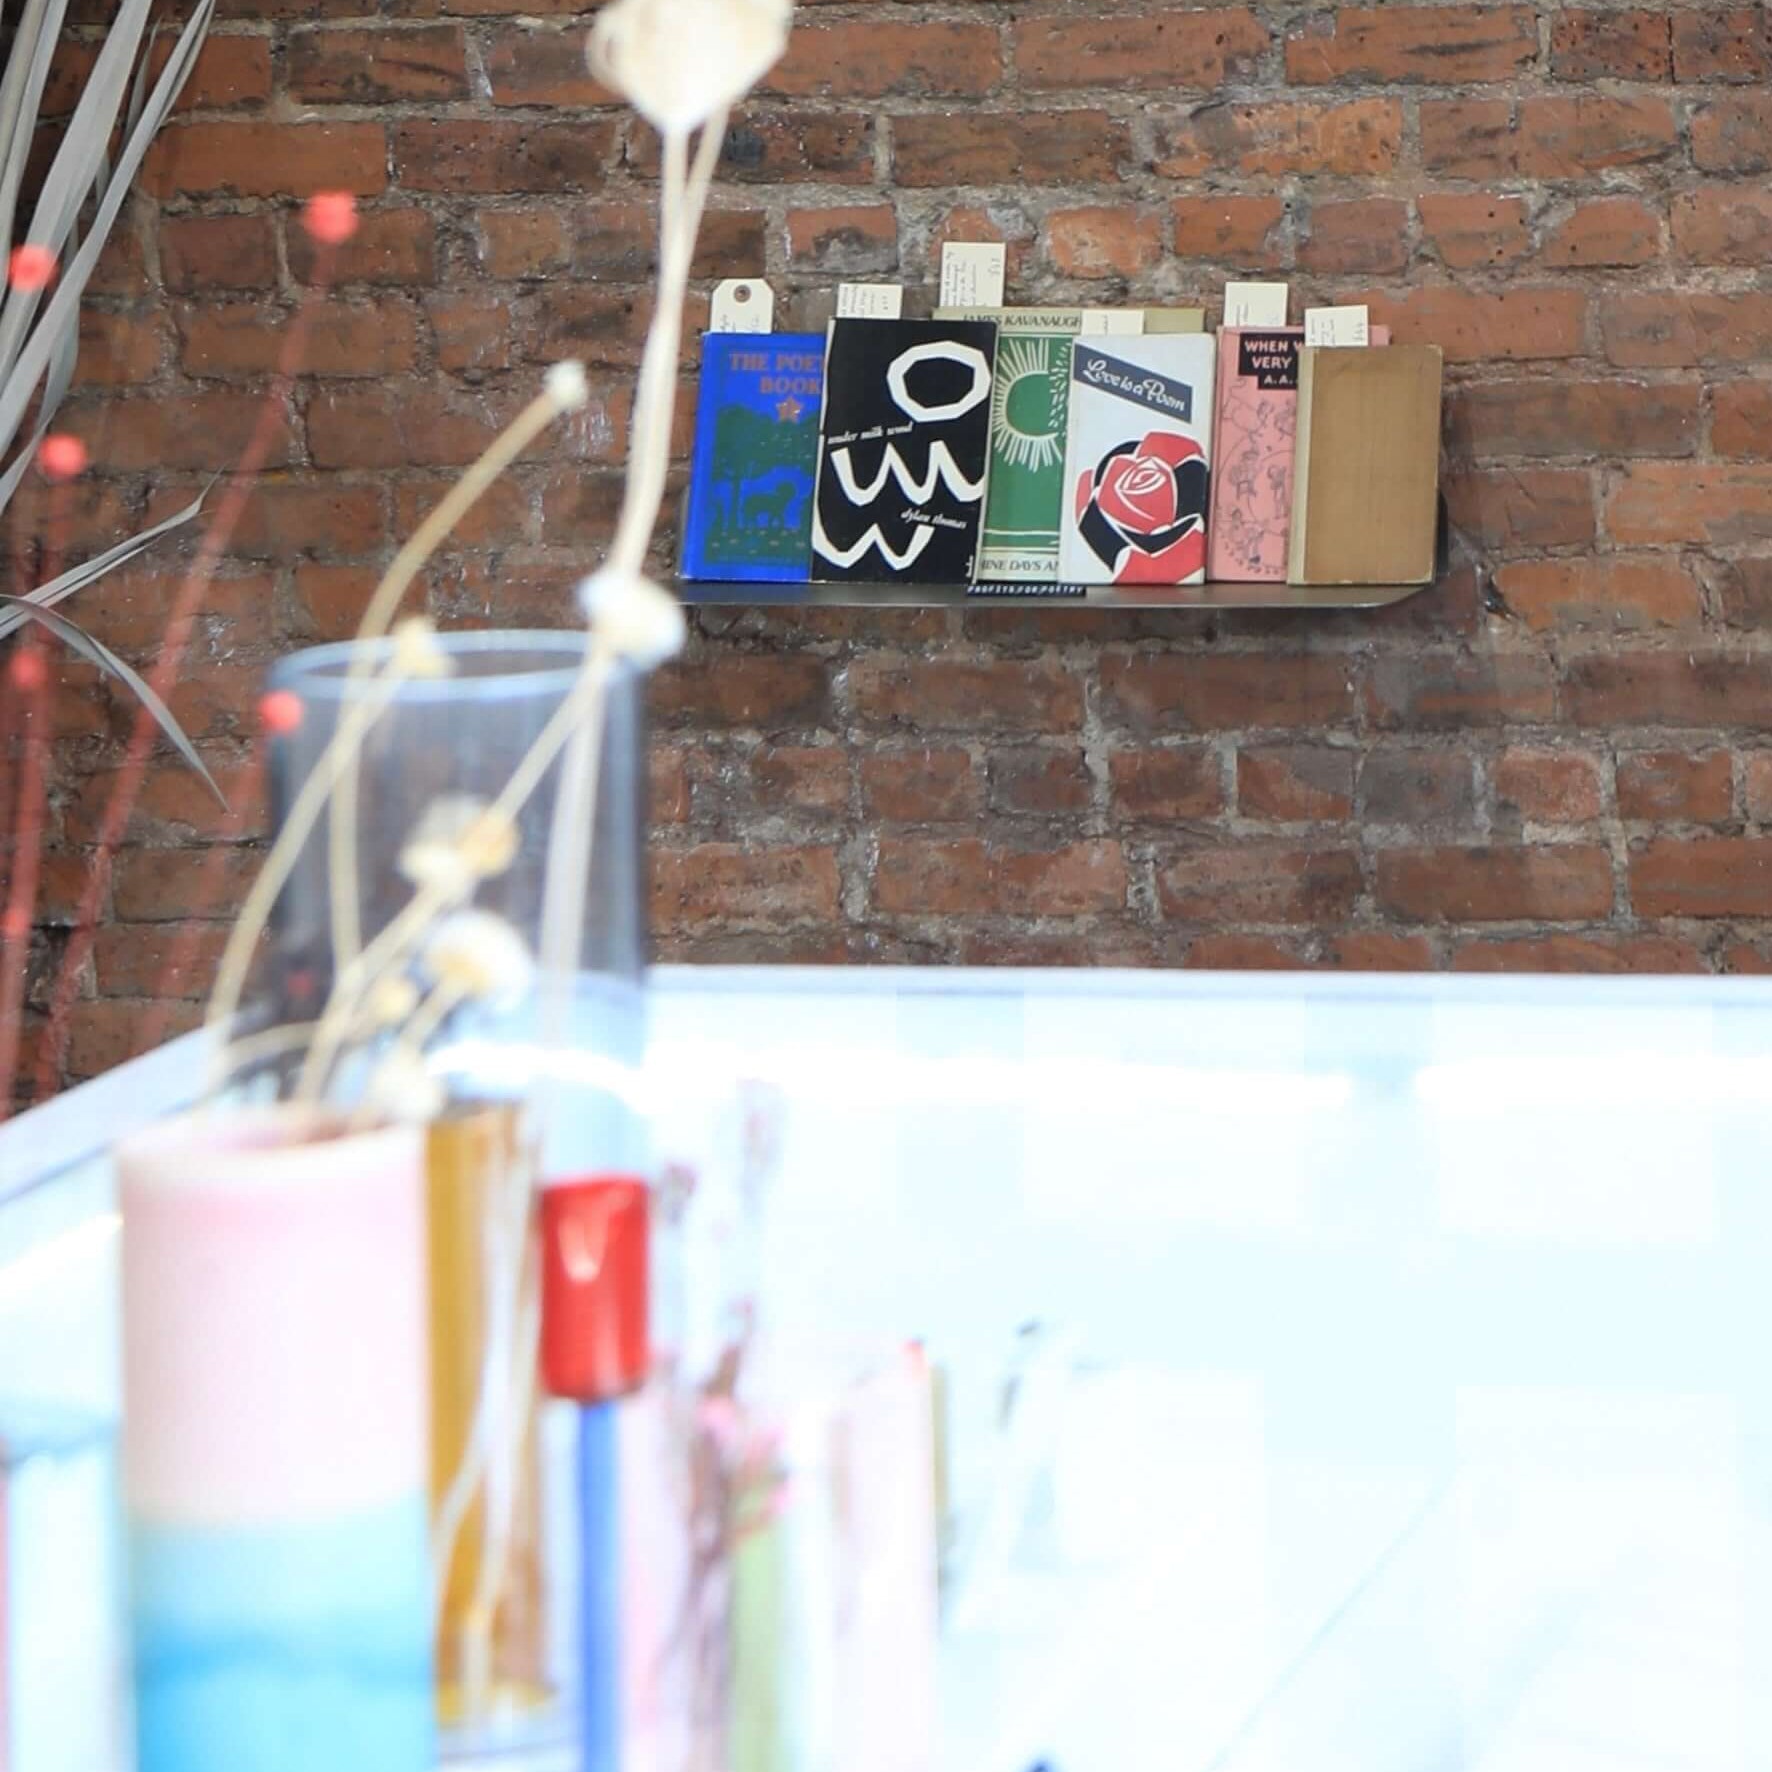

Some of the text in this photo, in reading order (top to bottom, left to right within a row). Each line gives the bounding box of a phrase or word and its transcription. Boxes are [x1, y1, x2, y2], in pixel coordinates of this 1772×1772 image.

[1244, 339, 1289, 353] WHEN
[728, 351, 768, 371] THE
[1251, 356, 1292, 369] VERY
